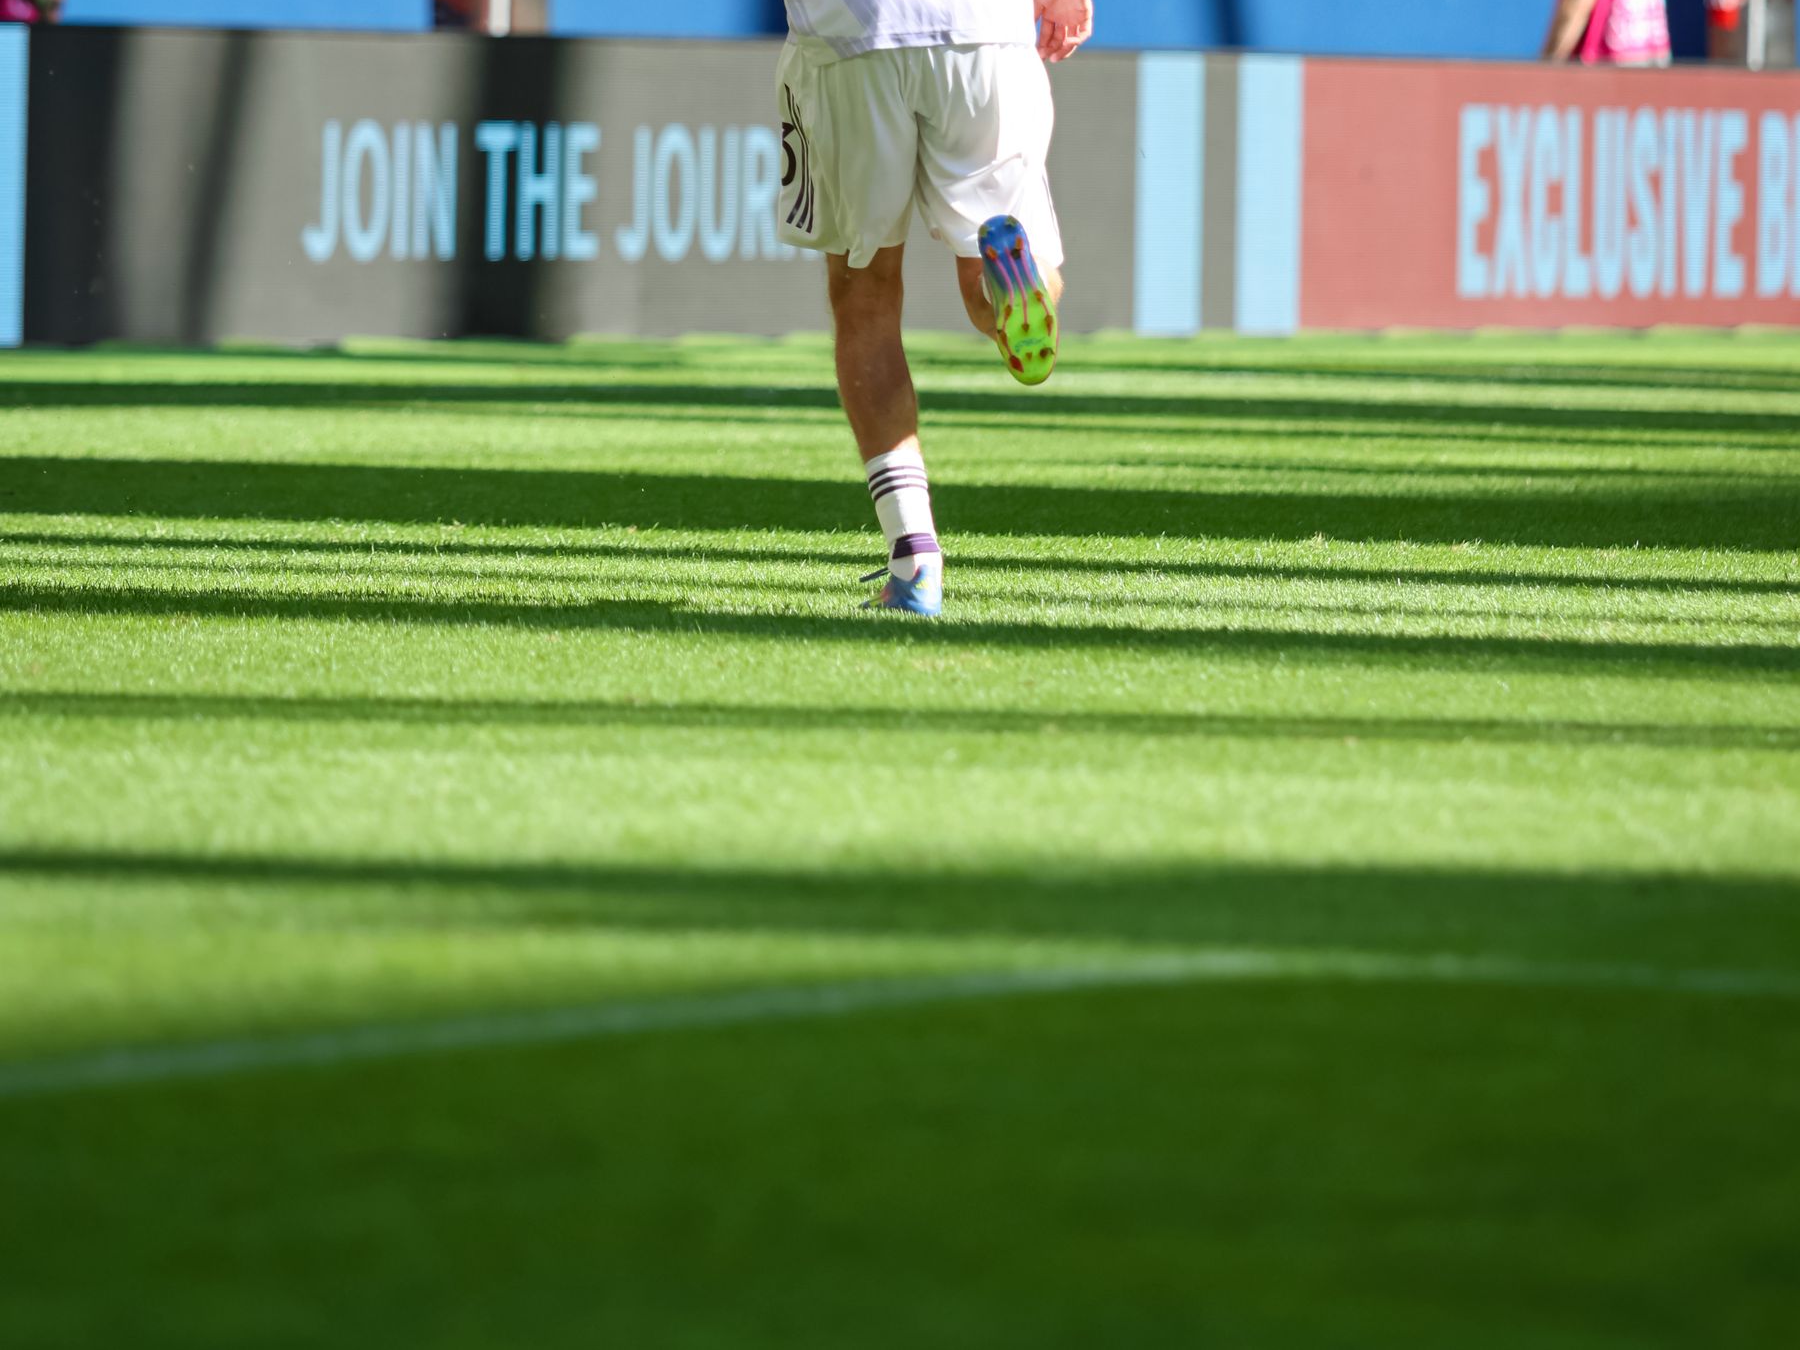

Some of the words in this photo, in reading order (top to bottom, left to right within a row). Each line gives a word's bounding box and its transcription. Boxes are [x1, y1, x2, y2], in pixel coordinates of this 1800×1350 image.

[303, 118, 458, 262] JOIN
[475, 120, 599, 261] THE
[616, 124, 826, 262] JOUR
[1458, 104, 1748, 299] EXCLUSIVE
